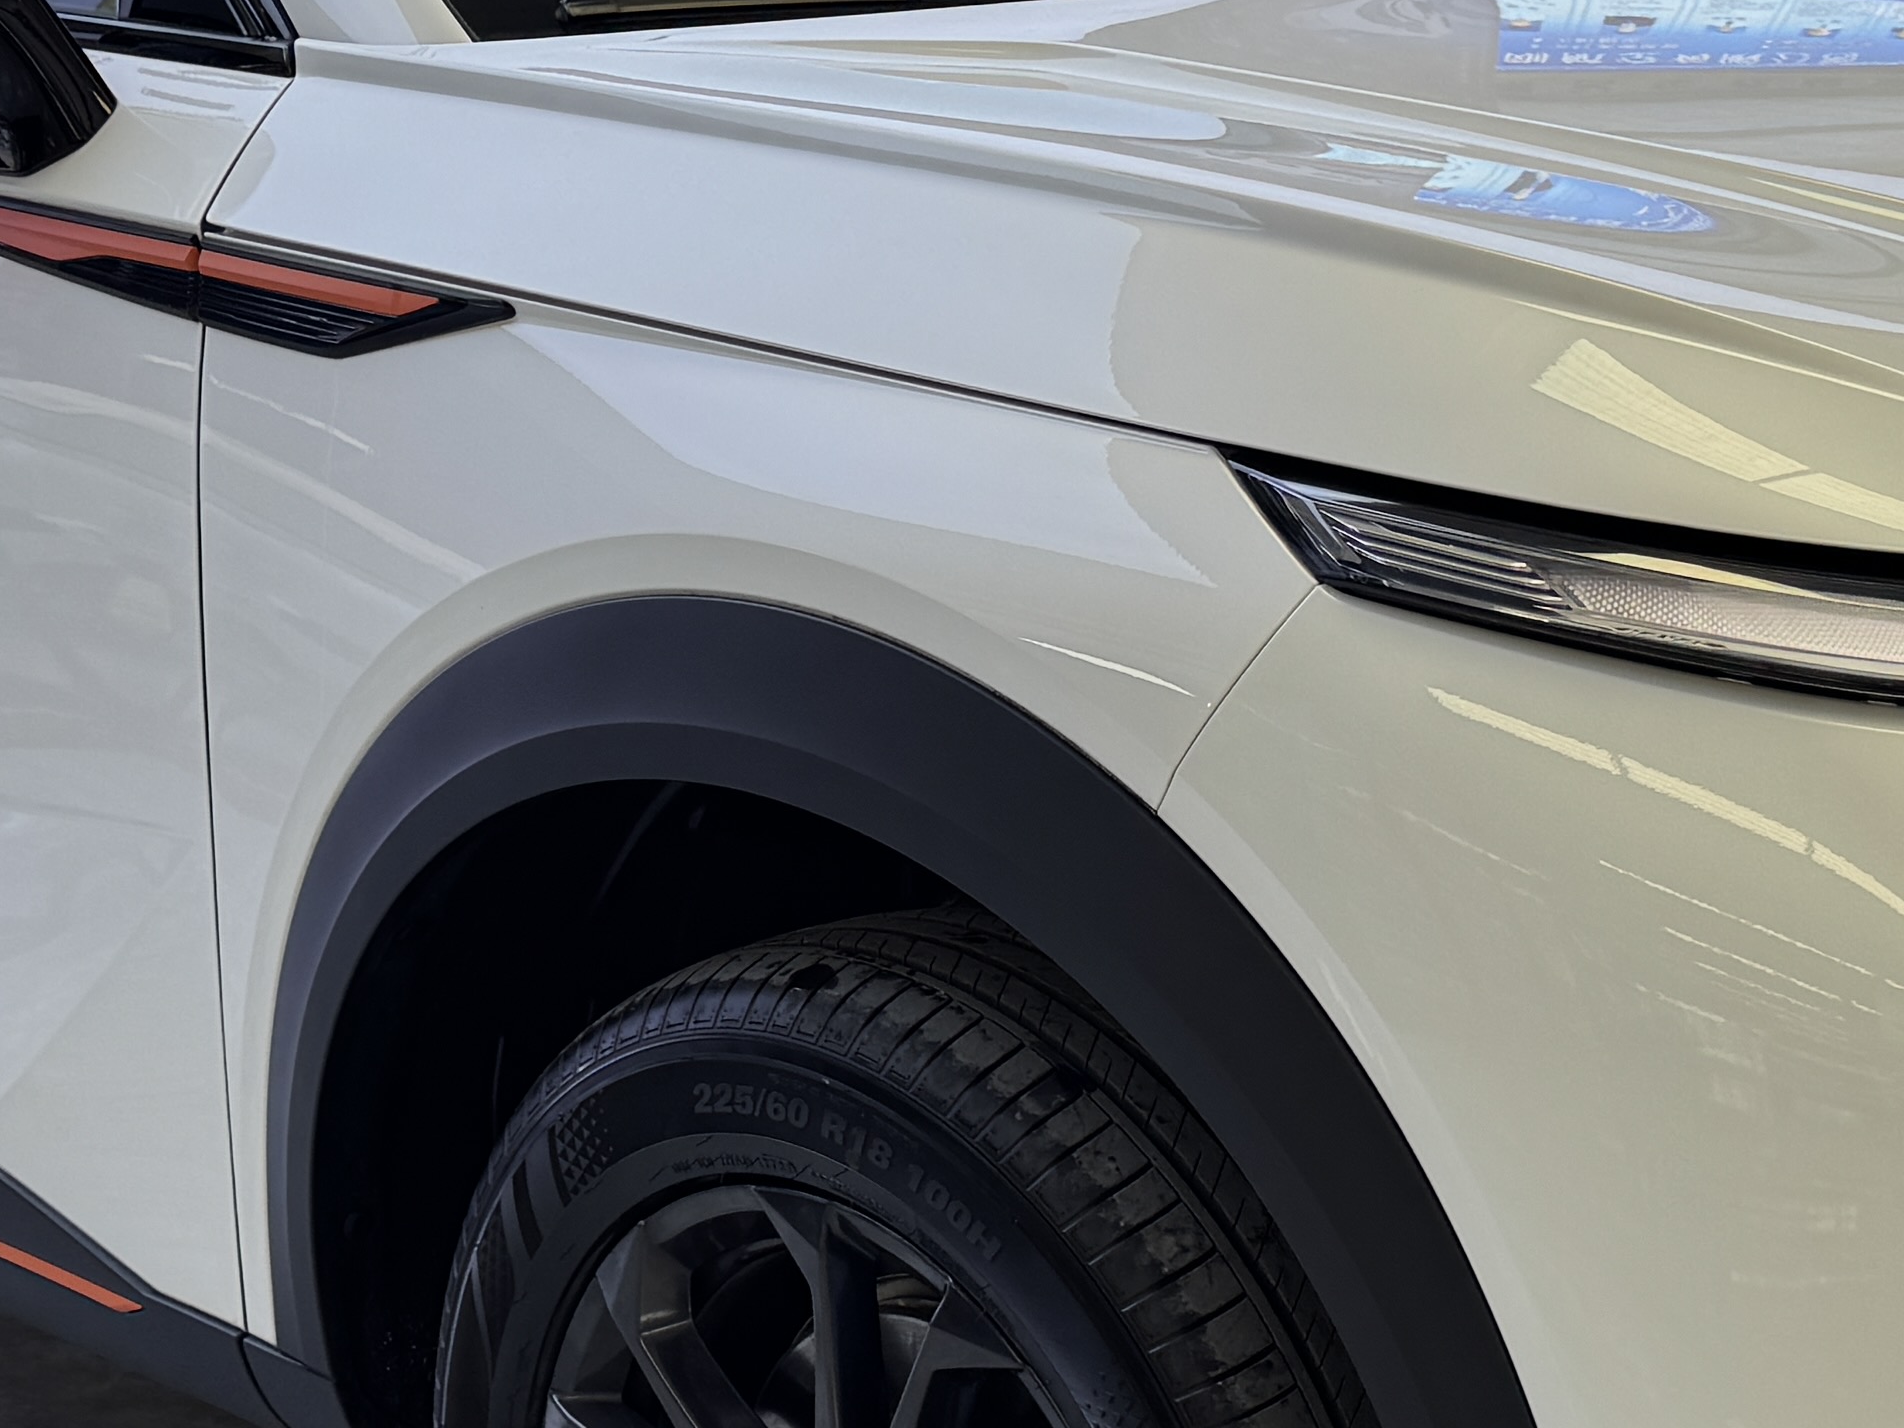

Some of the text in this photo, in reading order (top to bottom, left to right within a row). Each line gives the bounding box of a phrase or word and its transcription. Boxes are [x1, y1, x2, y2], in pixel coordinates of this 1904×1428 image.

[693, 1082, 810, 1130] 225/60
[821, 1108, 895, 1171] R18
[907, 1163, 1004, 1263] 100H
